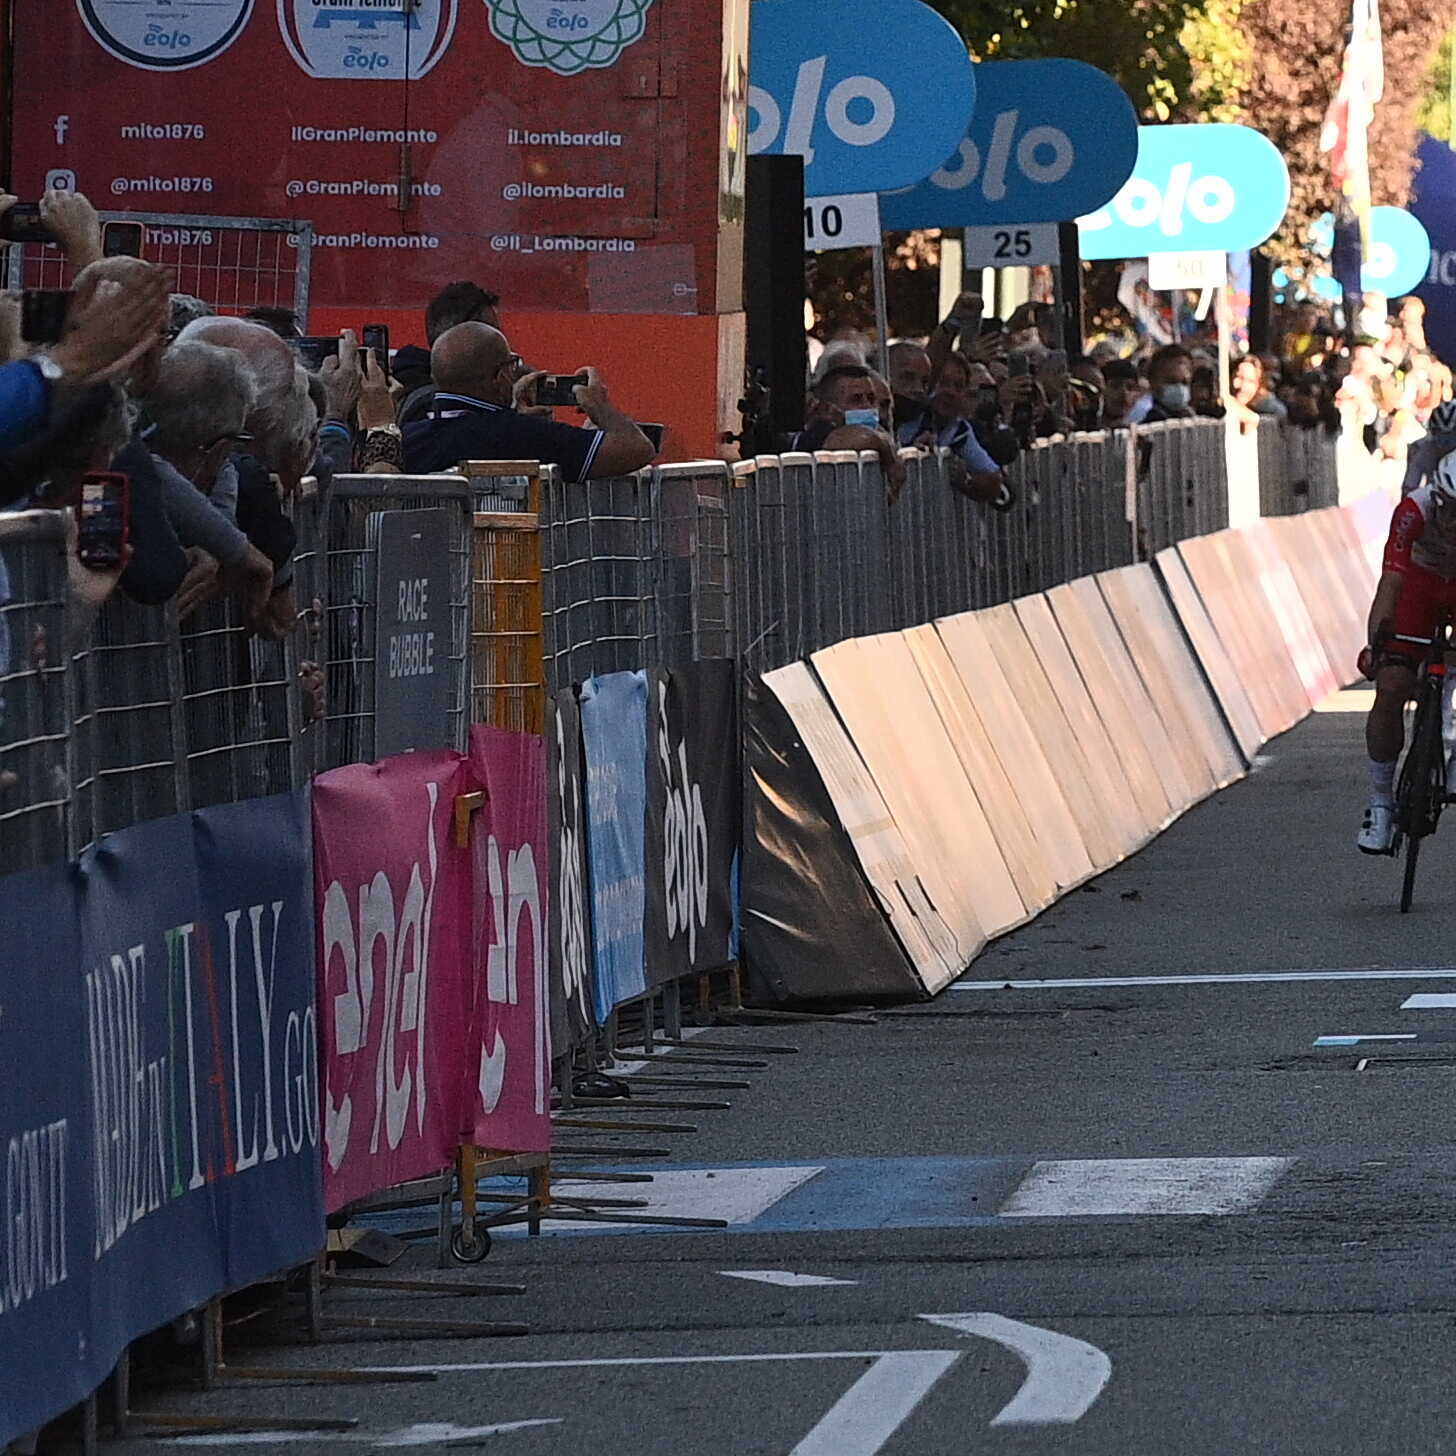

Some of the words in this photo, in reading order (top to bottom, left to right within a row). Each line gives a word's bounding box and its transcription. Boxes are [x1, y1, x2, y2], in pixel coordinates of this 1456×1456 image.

[143, 29, 191, 51] eolo
[547, 15, 588, 31] eolo
[343, 50, 389, 70] eolo
[121, 124, 205, 140] mito1876
[292, 126, 437, 143] IlGranPiemonte
[110, 177, 213, 195] @mito1876
[286, 180, 441, 198] @GranPiemnte
[502, 180, 625, 201] @ilombardia
[1090, 161, 1236, 236] olo
[804, 204, 843, 238] 10
[994, 230, 1032, 259] 25
[398, 579, 428, 621] RACE
[390, 633, 434, 678] BUBBLE
[665, 738, 708, 965] eolo
[324, 781, 438, 1172] enel
[480, 835, 549, 1114] en
